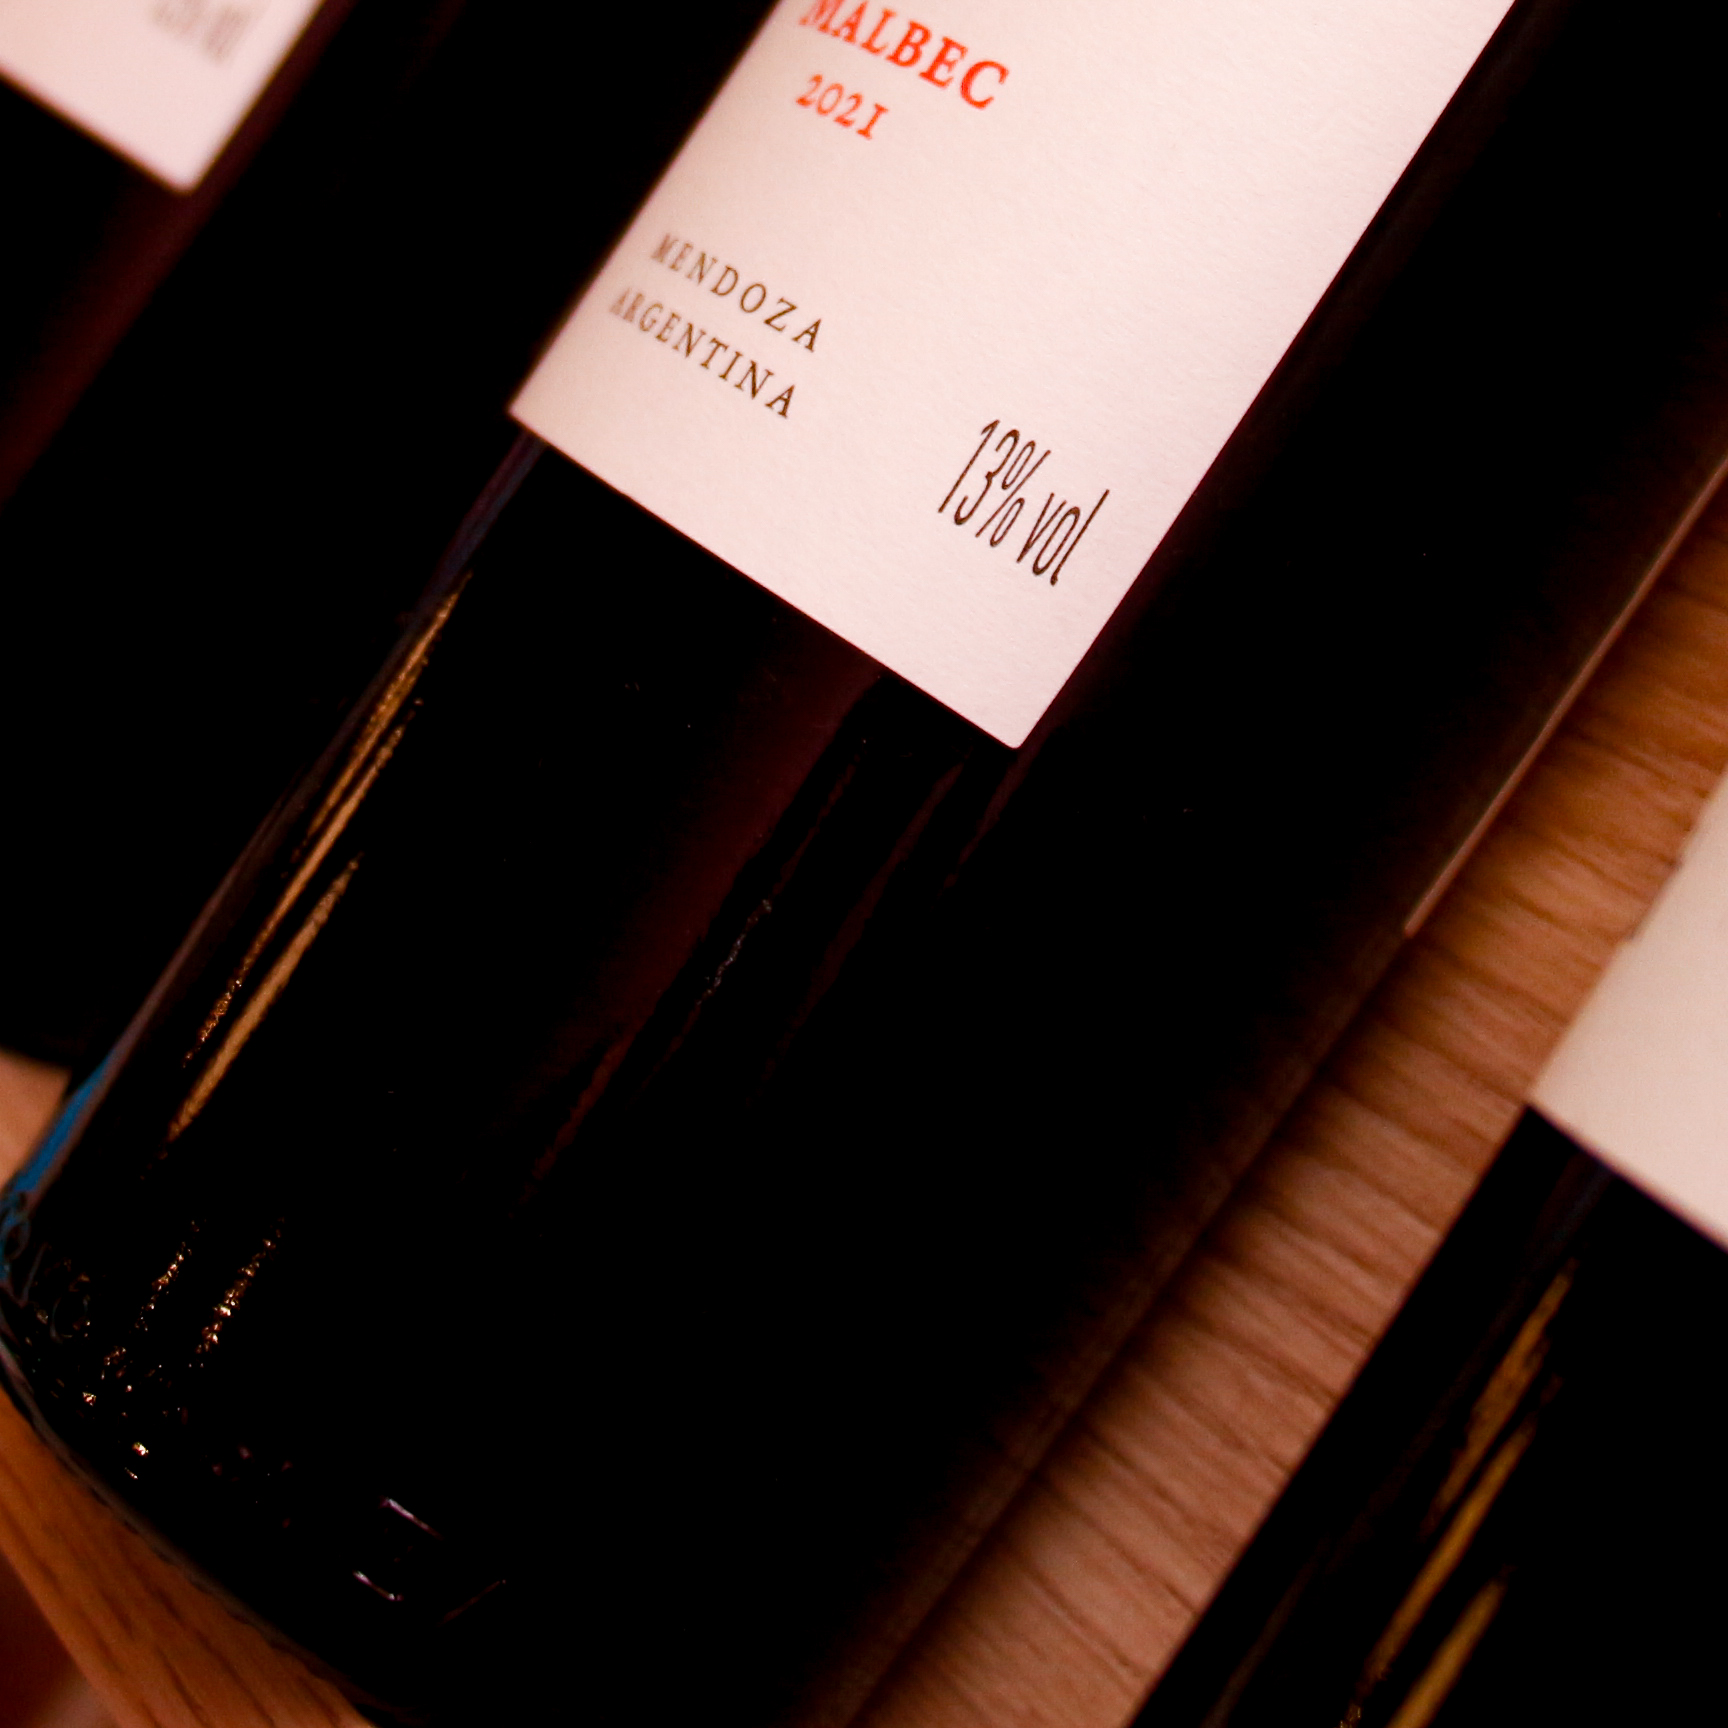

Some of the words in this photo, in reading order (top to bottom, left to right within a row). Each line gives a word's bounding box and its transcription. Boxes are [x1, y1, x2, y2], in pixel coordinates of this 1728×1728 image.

[795, 73, 890, 140] 2021
[609, 286, 796, 420] ARGENTINA
[651, 232, 823, 354] MENDOZA
[937, 418, 1052, 548] 13%
[1015, 488, 1111, 586] vol
